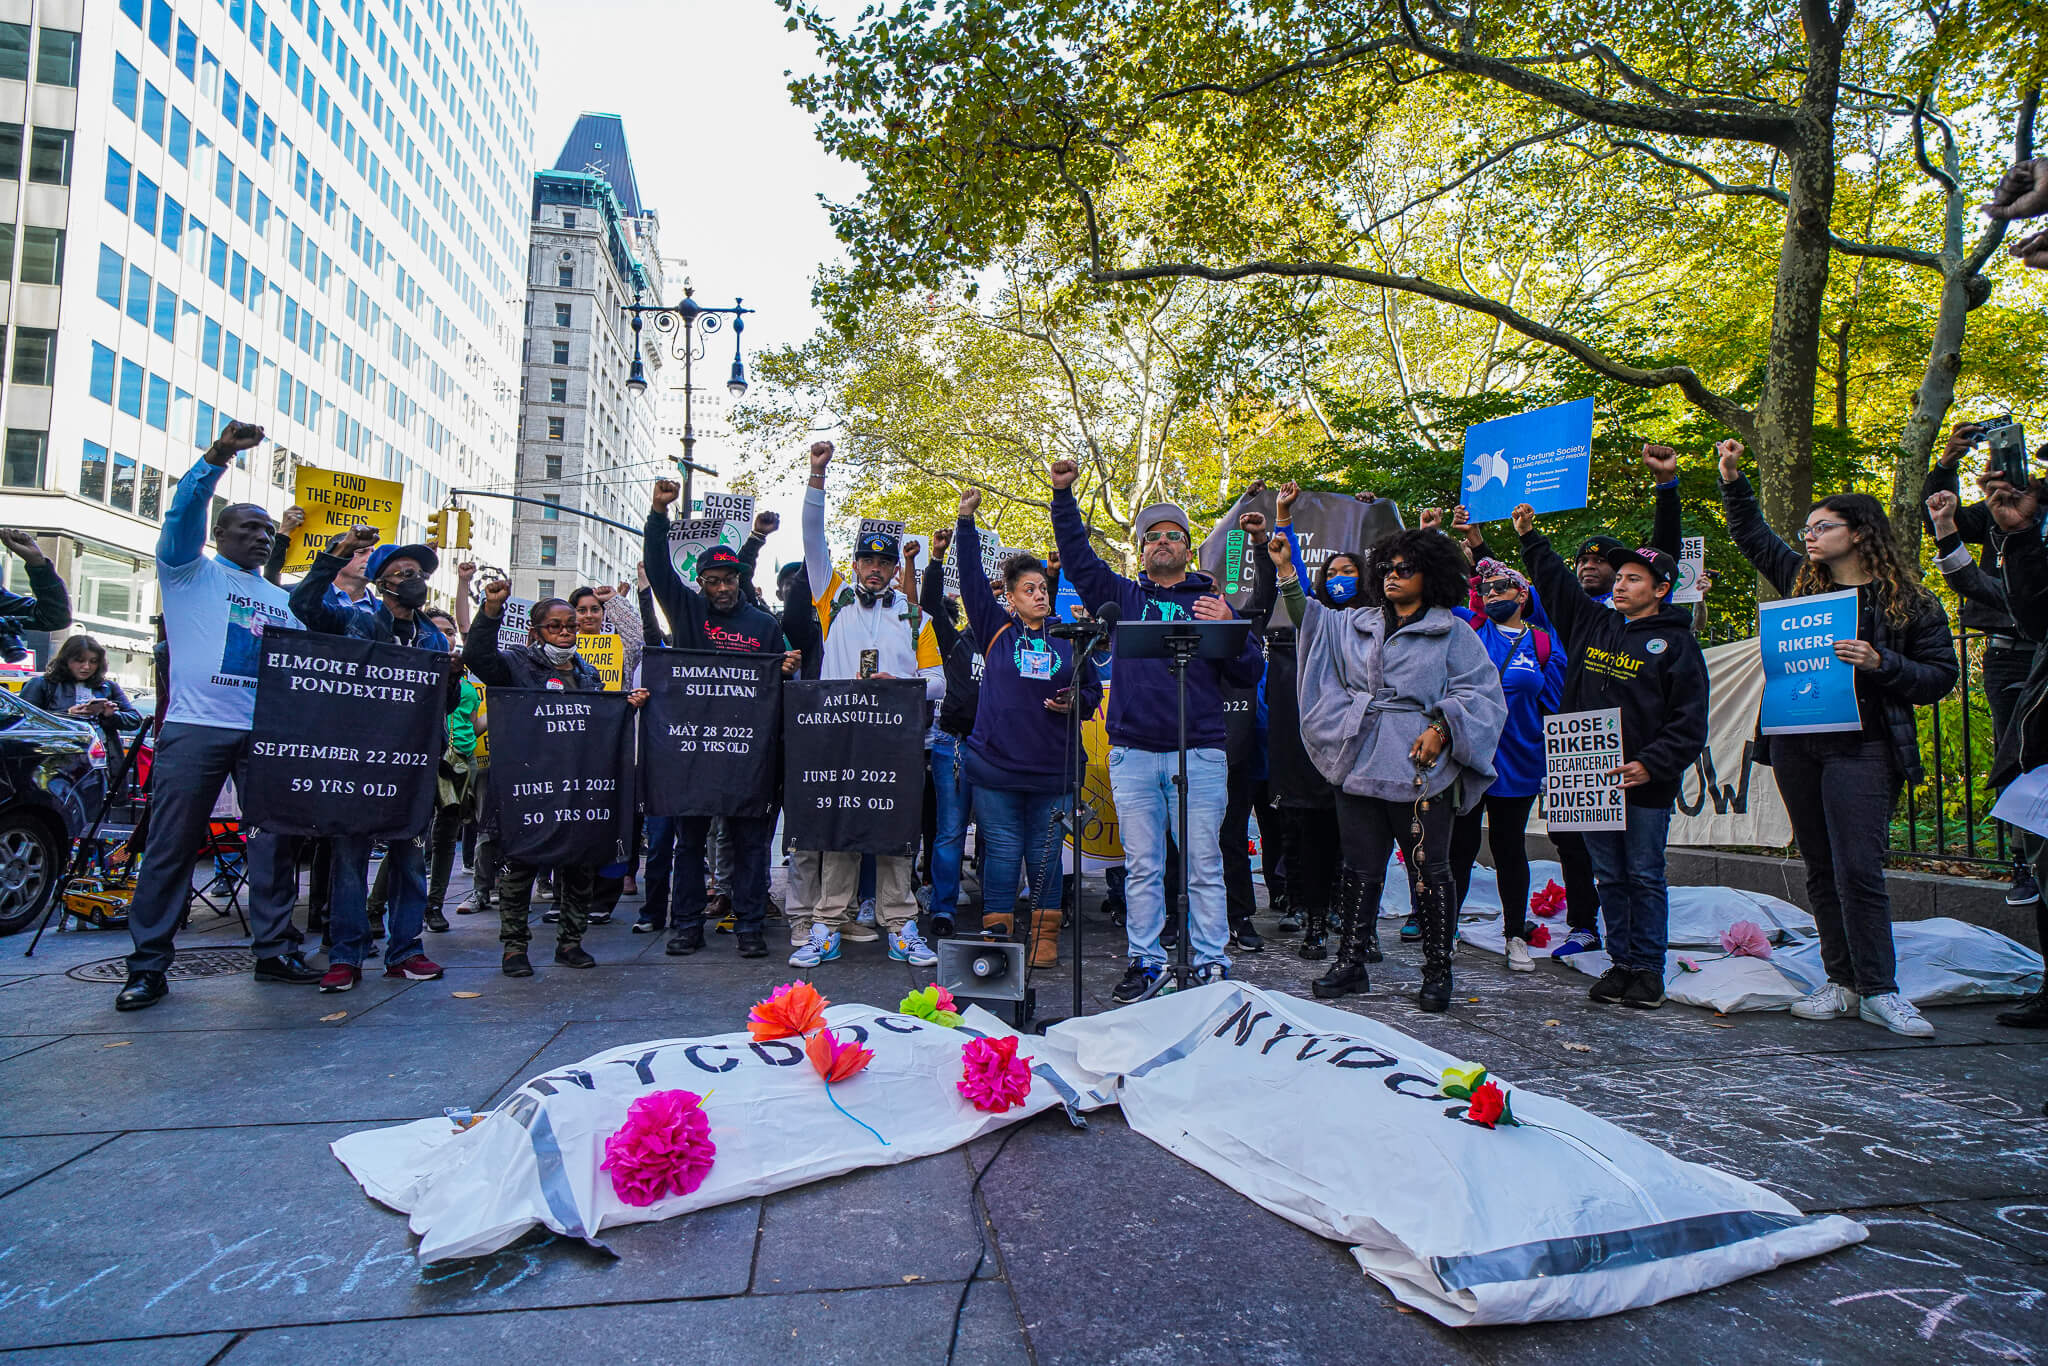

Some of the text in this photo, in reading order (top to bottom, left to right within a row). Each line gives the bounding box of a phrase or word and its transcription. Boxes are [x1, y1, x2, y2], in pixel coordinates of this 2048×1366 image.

[1512, 444, 1585, 464] The Fortune Society
[333, 473, 366, 493] FUND
[306, 486, 393, 513] THE PEOPLE'S
[705, 495, 752, 511] CLOSE
[326, 510, 368, 527] NEEDS
[704, 508, 751, 522] RIKERS
[669, 520, 723, 531] CLOSE
[861, 521, 902, 535] CLOSE
[667, 530, 719, 541] RIKERS
[1228, 530, 1243, 547] FOR
[1228, 548, 1241, 575] STAND
[269, 605, 289, 620] FOR
[1781, 612, 1833, 631] CLOSE
[592, 637, 612, 649] FOR
[1778, 633, 1834, 653] RIKERS
[266, 652, 440, 686] ELMORE ROBERT
[671, 666, 760, 681] EMMANUEL
[1784, 656, 1830, 674] NOW!
[211, 676, 240, 688] ELIJAH
[290, 676, 416, 703] PONDEXTER
[685, 683, 757, 698] SULLIVAN
[823, 693, 880, 707] ANIBAL
[534, 703, 593, 717] ALBERT
[796, 710, 903, 726] CARRASQUILLO
[546, 719, 587, 734] DRYE
[668, 724, 754, 739] MAY 28 2022
[1546, 717, 1602, 735] CLOSE
[680, 740, 750, 754] 20 YRS OLD
[1547, 733, 1619, 754] RIKERS
[253, 741, 428, 766] SEPTEMBER 22 2022
[1548, 754, 1621, 773] DECARCERATE
[802, 768, 897, 784] JUNE 20 2022
[1548, 772, 1620, 790] DEFEND
[291, 778, 398, 797] 59 YRS OLD
[511, 779, 617, 797] JUNE 21 2022
[815, 796, 832, 809] 39
[867, 797, 895, 811] OLD
[1549, 789, 1622, 809] DIVEST &
[522, 808, 611, 826] 50 YRS OLD
[1549, 807, 1623, 824] REDISTRIBUTE
